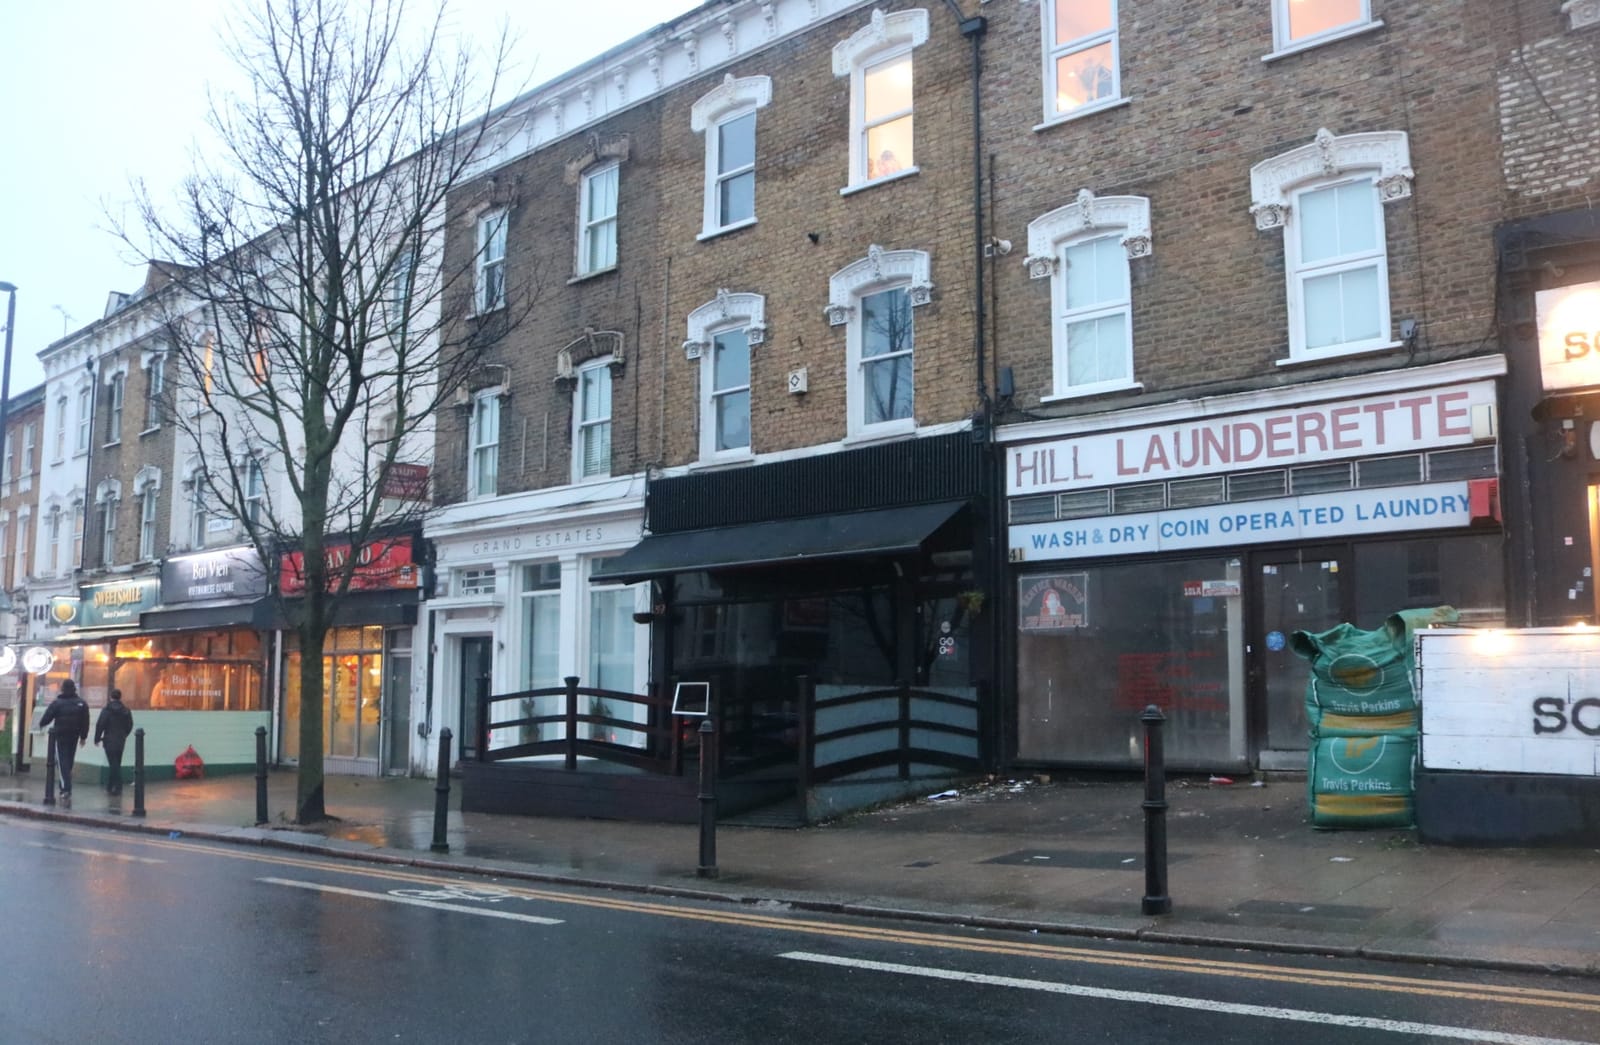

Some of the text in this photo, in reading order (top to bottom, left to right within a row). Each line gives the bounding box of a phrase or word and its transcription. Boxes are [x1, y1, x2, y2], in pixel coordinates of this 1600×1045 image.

[1565, 331, 1600, 361] S
[1015, 391, 1472, 488] HILL LAUNDERETTE
[1032, 494, 1471, 550] WASH & DRY COIN OPERATED LAUNDRY
[472, 527, 604, 555] GRAND ESTATES
[1009, 547, 1023, 561] 41
[1361, 699, 1401, 713] Perkins
[1322, 778, 1392, 791] Travis Perkins
